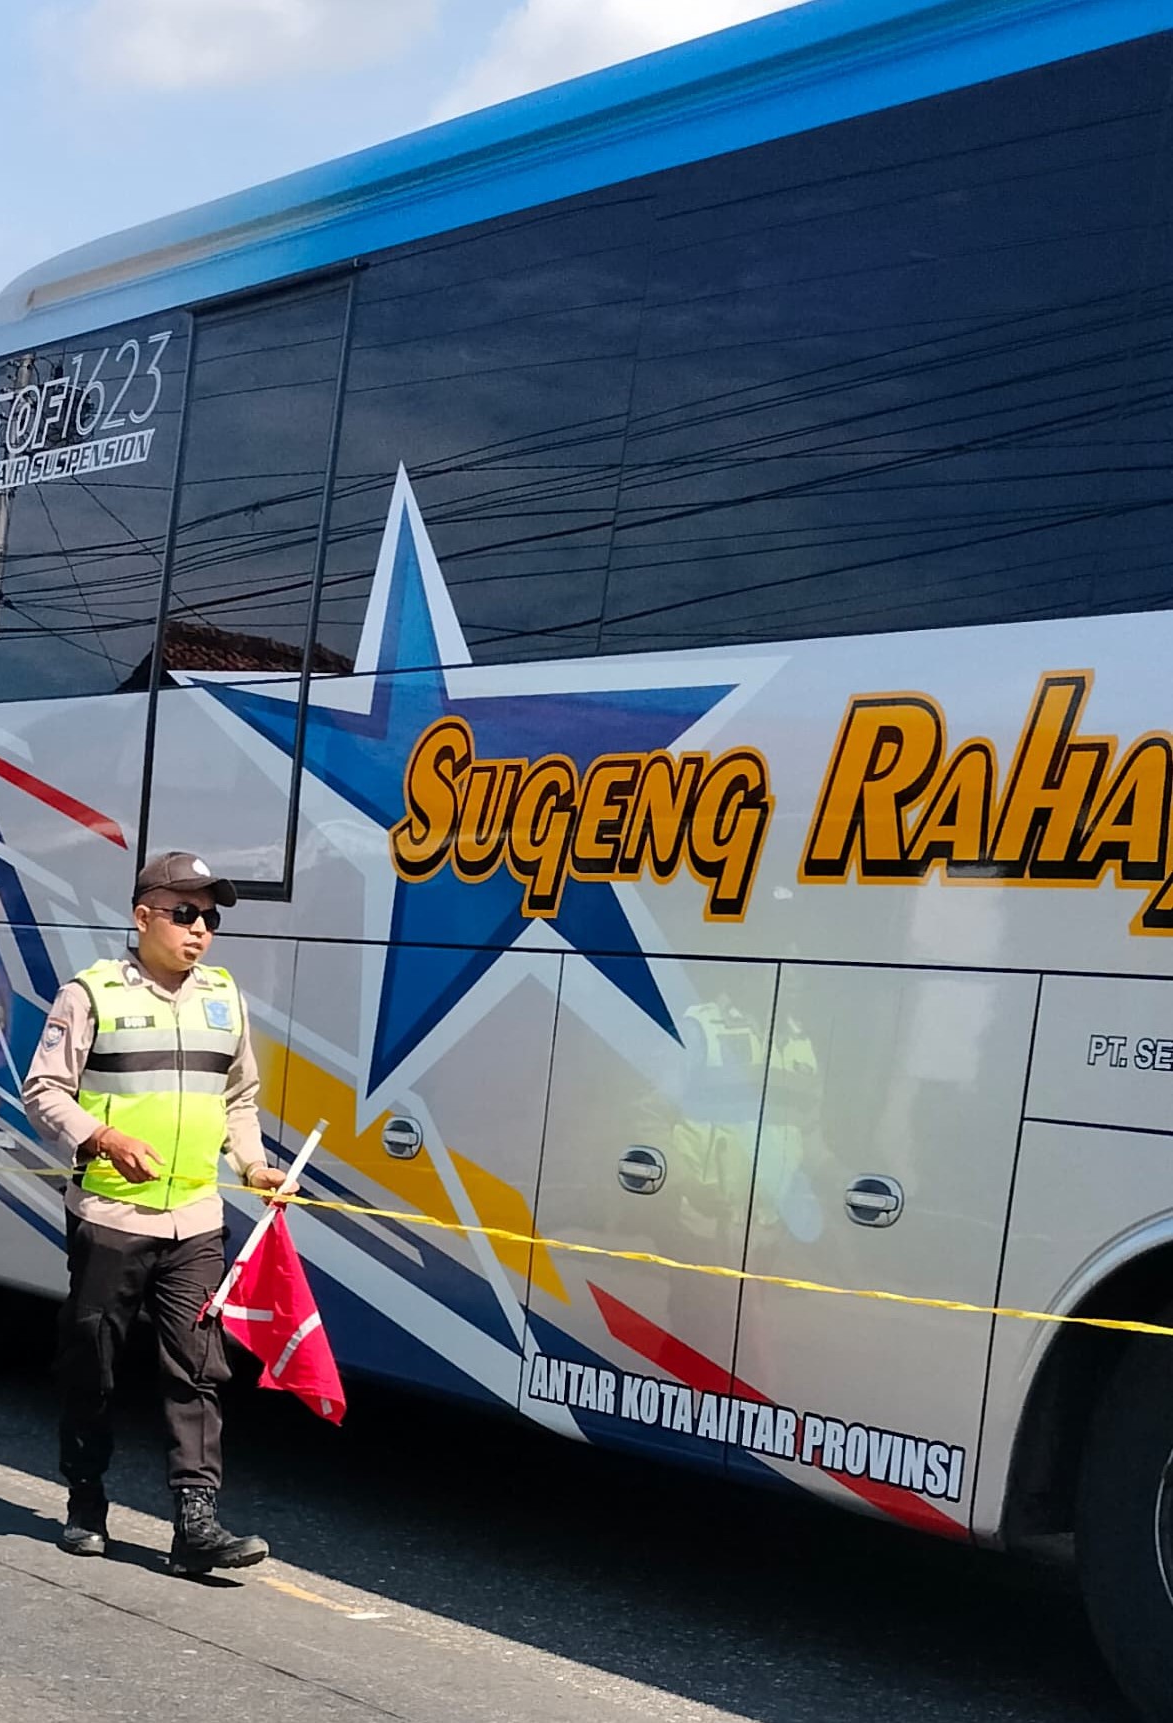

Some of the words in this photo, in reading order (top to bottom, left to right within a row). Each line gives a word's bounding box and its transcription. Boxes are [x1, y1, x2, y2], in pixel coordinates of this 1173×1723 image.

[60, 330, 173, 438] 1623
[28, 428, 156, 484] SUSPENSION
[797, 668, 1173, 937] RAHA
[1087, 1034, 1128, 1068] PT.
[528, 1355, 616, 1415] ANTAR
[620, 1373, 697, 1435] KOTA
[799, 1411, 966, 1502] PROVINSI
